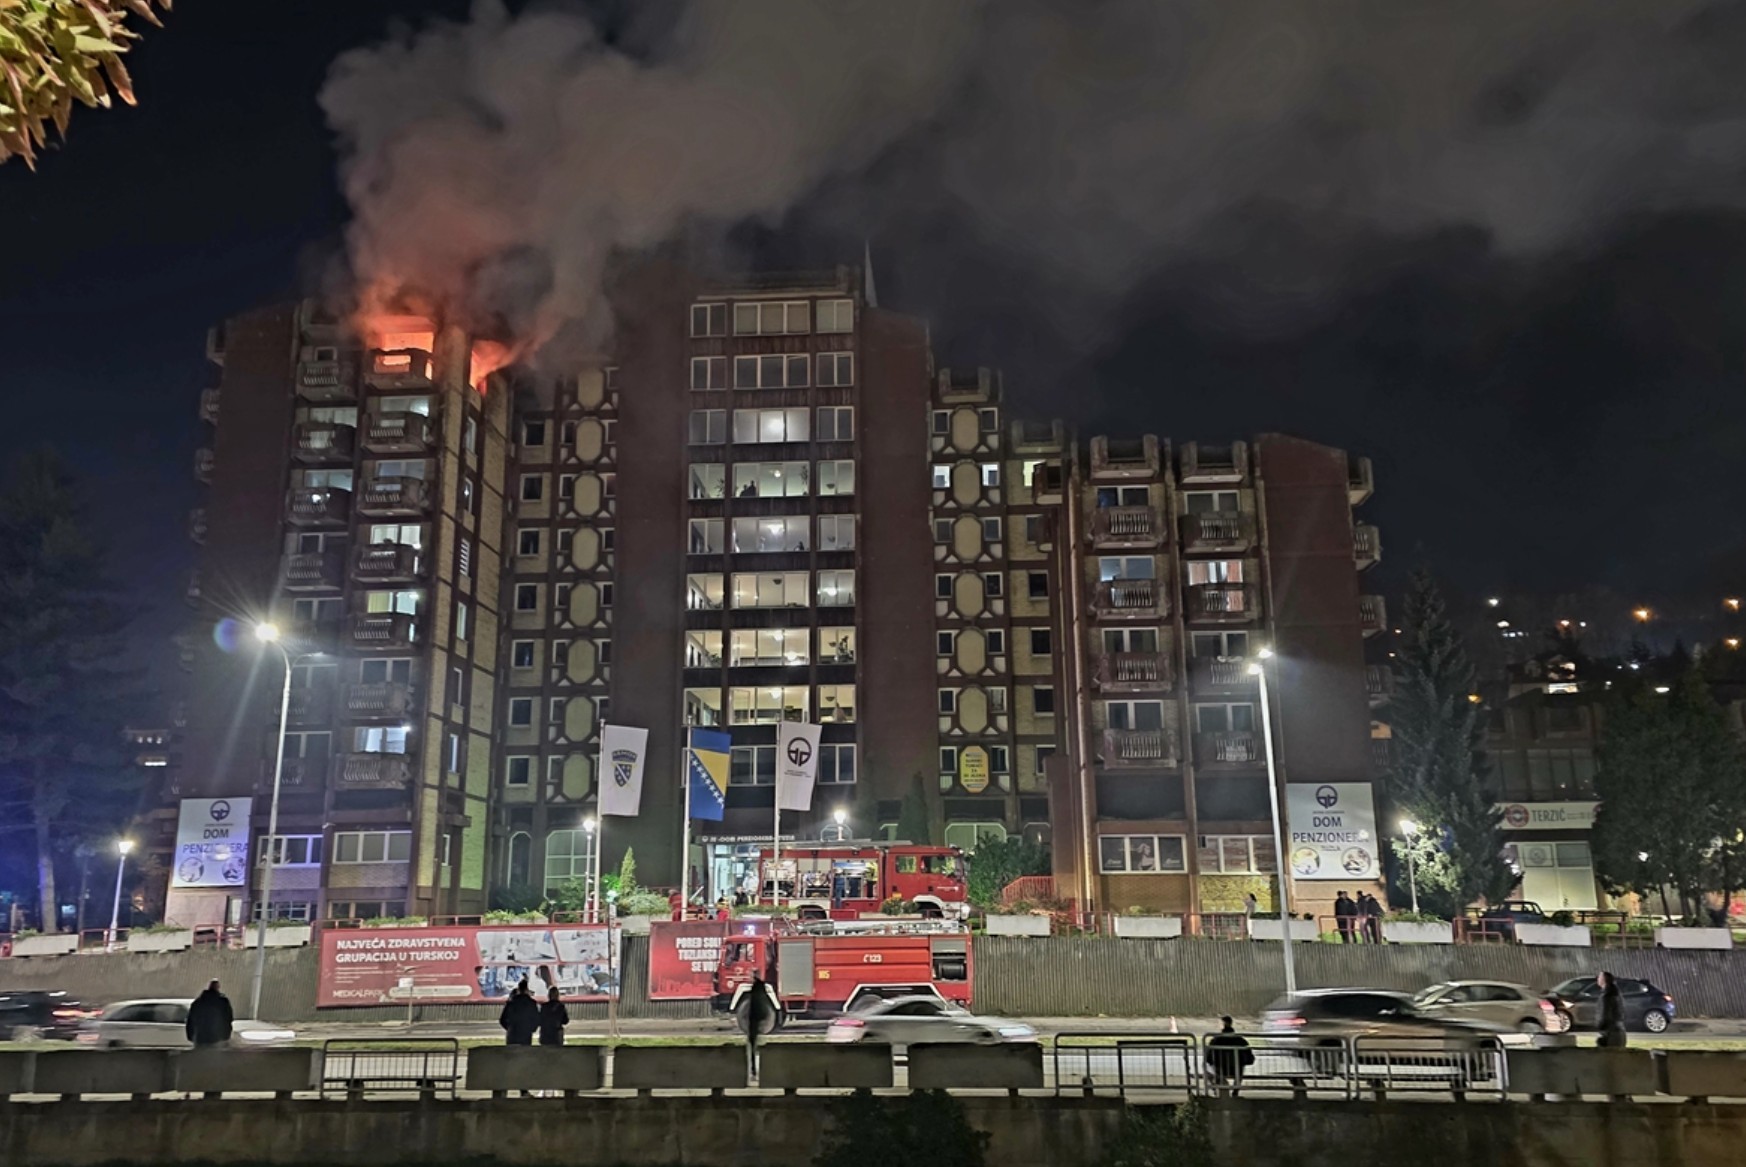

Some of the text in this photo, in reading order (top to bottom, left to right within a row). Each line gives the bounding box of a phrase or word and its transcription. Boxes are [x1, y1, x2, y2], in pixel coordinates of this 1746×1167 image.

[1313, 816, 1342, 827] DOM
[203, 828, 229, 839] DOM
[336, 937, 466, 949] NAJVEĆA ZDRAVSTVENA
[335, 951, 459, 963] GRUPACIJA U TURSKOJ
